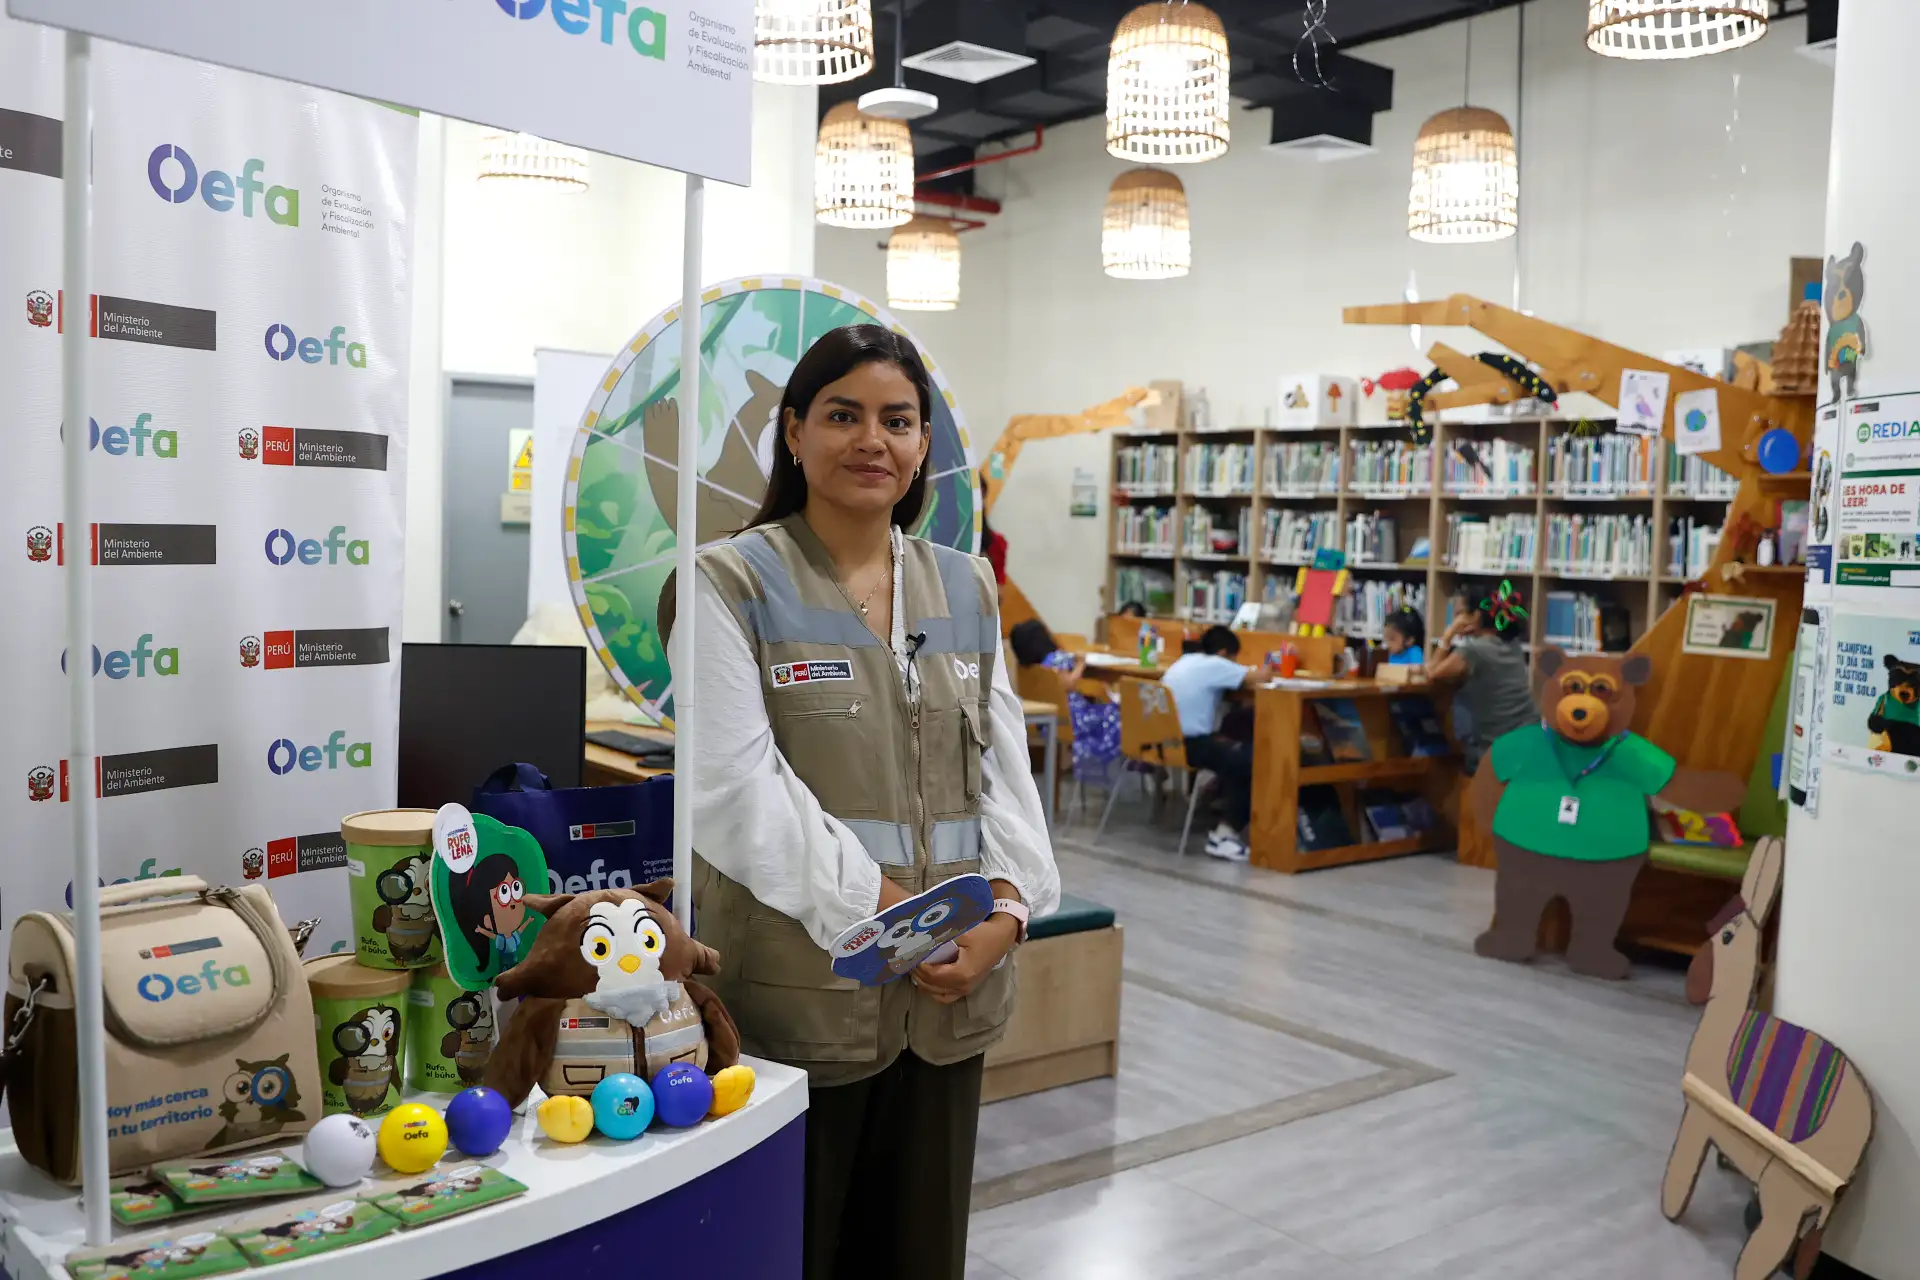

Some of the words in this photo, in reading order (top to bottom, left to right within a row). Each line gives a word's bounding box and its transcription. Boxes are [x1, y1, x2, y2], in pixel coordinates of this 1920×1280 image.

[688, 11, 736, 35] Organismo
[688, 28, 701, 40] de
[701, 31, 748, 55] Evaluación
[687, 45, 694, 56] y
[695, 45, 749, 71] Fiscalización
[686, 60, 732, 81] Ambiental
[147, 143, 299, 227] Oefa
[321, 184, 362, 202] Organismo
[321, 197, 332, 206] de
[334, 199, 372, 217] Evaluación
[321, 211, 328, 220] y
[329, 211, 375, 229] Fiscalización
[321, 223, 360, 238] Ambiental
[103, 311, 150, 327] Ministerio
[103, 322, 119, 334] del
[120, 324, 163, 339] Ambiente
[264, 323, 367, 368] Oefa
[265, 439, 290, 452] PERÚ
[299, 442, 344, 453] Ministerio
[298, 452, 313, 461] del
[314, 453, 357, 463] Ambiente
[1859, 484, 1887, 495] HORA
[1890, 483, 1905, 494] DE
[1842, 497, 1868, 508] LEER!
[104, 538, 150, 549] Ministerio
[264, 525, 370, 566] Oefa
[104, 549, 119, 559] del
[121, 549, 163, 559] Ambiente
[267, 641, 290, 656] PERÚ
[299, 643, 343, 653] Ministerio
[1837, 641, 1873, 656] PLANIFICA
[299, 652, 312, 662] del
[313, 652, 357, 661] Ambiente
[1836, 655, 1844, 666] TU
[1861, 657, 1874, 669] SIN
[794, 668, 808, 678] PERÚ
[953, 659, 979, 680] Oe
[1835, 667, 1868, 682] PLÁSTICO
[1834, 681, 1842, 692] DE
[1844, 683, 1854, 694] UN
[1856, 684, 1877, 697] SOLO
[267, 730, 372, 775] Oefa
[106, 766, 152, 780] Ministerio
[106, 780, 122, 790] del
[123, 775, 165, 788] Ambiente
[270, 849, 293, 865] PERÚ
[301, 845, 344, 857] Ministerio
[301, 857, 314, 867] del
[315, 853, 348, 864] Ambien
[642, 858, 673, 867] Organism
[137, 959, 251, 1002] Oefa
[425, 1062, 447, 1071] Rufo,
[434, 1070, 456, 1079] búho
[670, 1075, 693, 1086] Oefa
[135, 1095, 163, 1113] más
[164, 1088, 208, 1104] cerca
[107, 1127, 118, 1138] n
[121, 1124, 138, 1136] tu
[140, 1104, 213, 1131] territorio
[403, 1129, 429, 1141] Oefa
